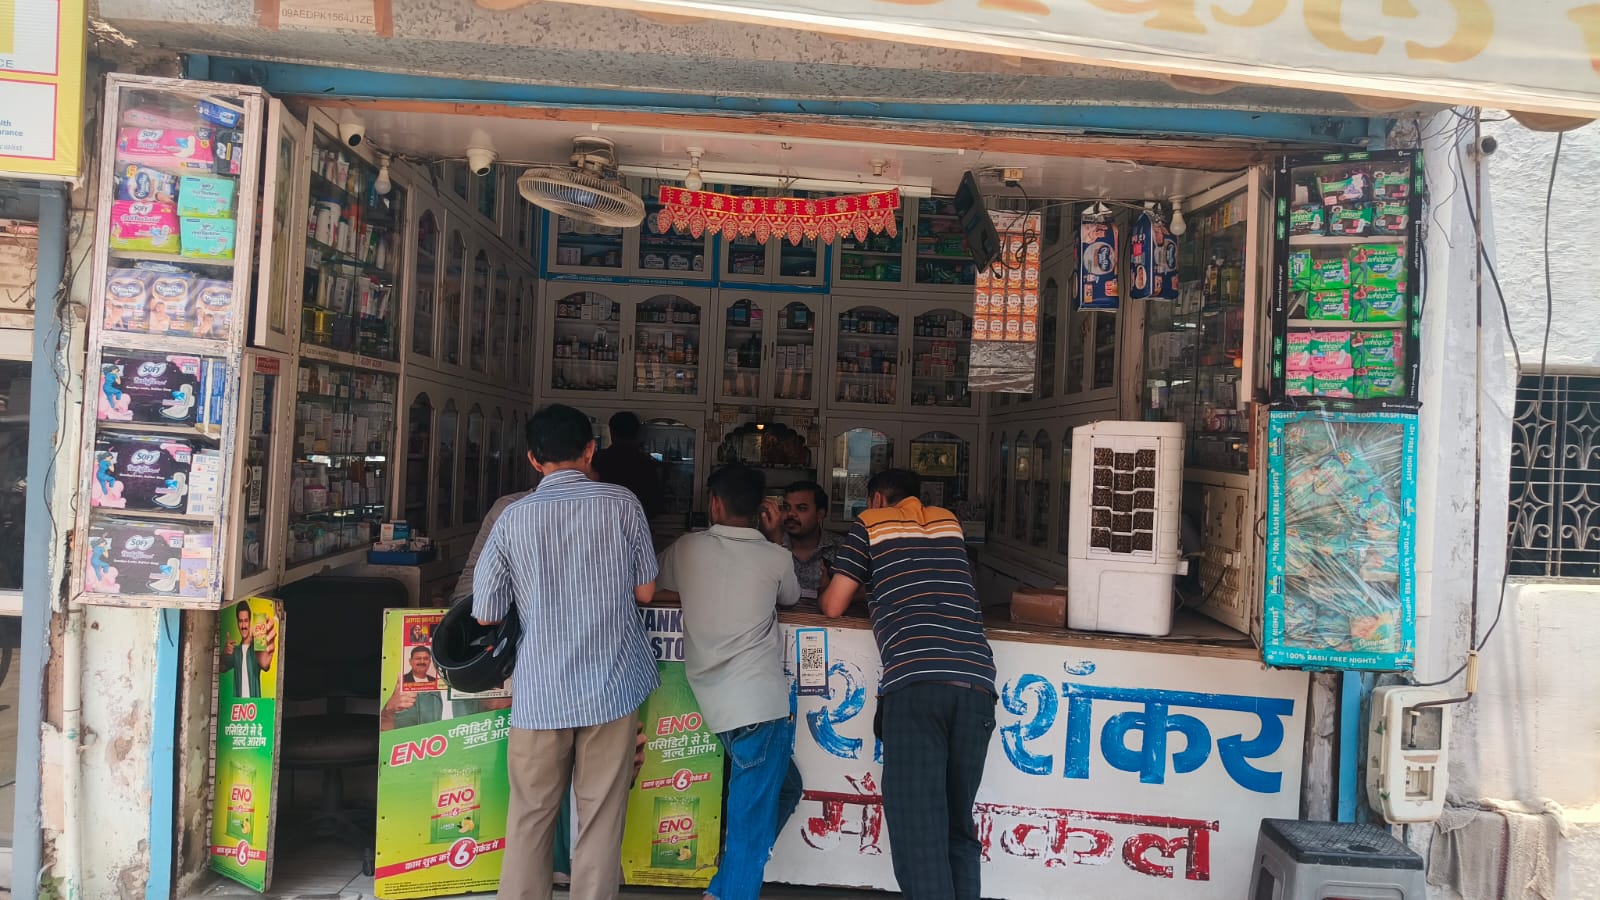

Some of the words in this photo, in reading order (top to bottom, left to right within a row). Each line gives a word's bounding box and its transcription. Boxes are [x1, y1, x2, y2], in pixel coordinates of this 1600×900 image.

[142, 365, 161, 374] SOFY
[136, 453, 154, 462] SOFY
[130, 539, 148, 548] SOFY
[1286, 652, 1305, 660] 100%
[1307, 654, 1327, 662] RASH
[1349, 657, 1377, 665] NIGHTS
[231, 703, 257, 721] ENO
[250, 723, 257, 736] से
[448, 717, 492, 738] एसिडिटी
[494, 715, 505, 729] से
[656, 712, 702, 736] ENO
[1000, 660, 1294, 794] शंकर
[463, 731, 489, 745] जल्द
[647, 735, 689, 751] एसिडिटी
[691, 732, 701, 745] से
[702, 731, 711, 744] दे
[390, 734, 448, 767] ENO
[662, 747, 685, 759] जल्द
[687, 743, 717, 756] आराम
[677, 773, 688, 789] 6
[231, 787, 252, 803] ENO
[437, 788, 475, 808] ENO
[658, 817, 693, 834] ENO
[239, 845, 246, 861] 6
[405, 859, 421, 871] काम
[422, 855, 437, 868] शुरू
[454, 843, 470, 865] 6
[492, 839, 500, 849] में
